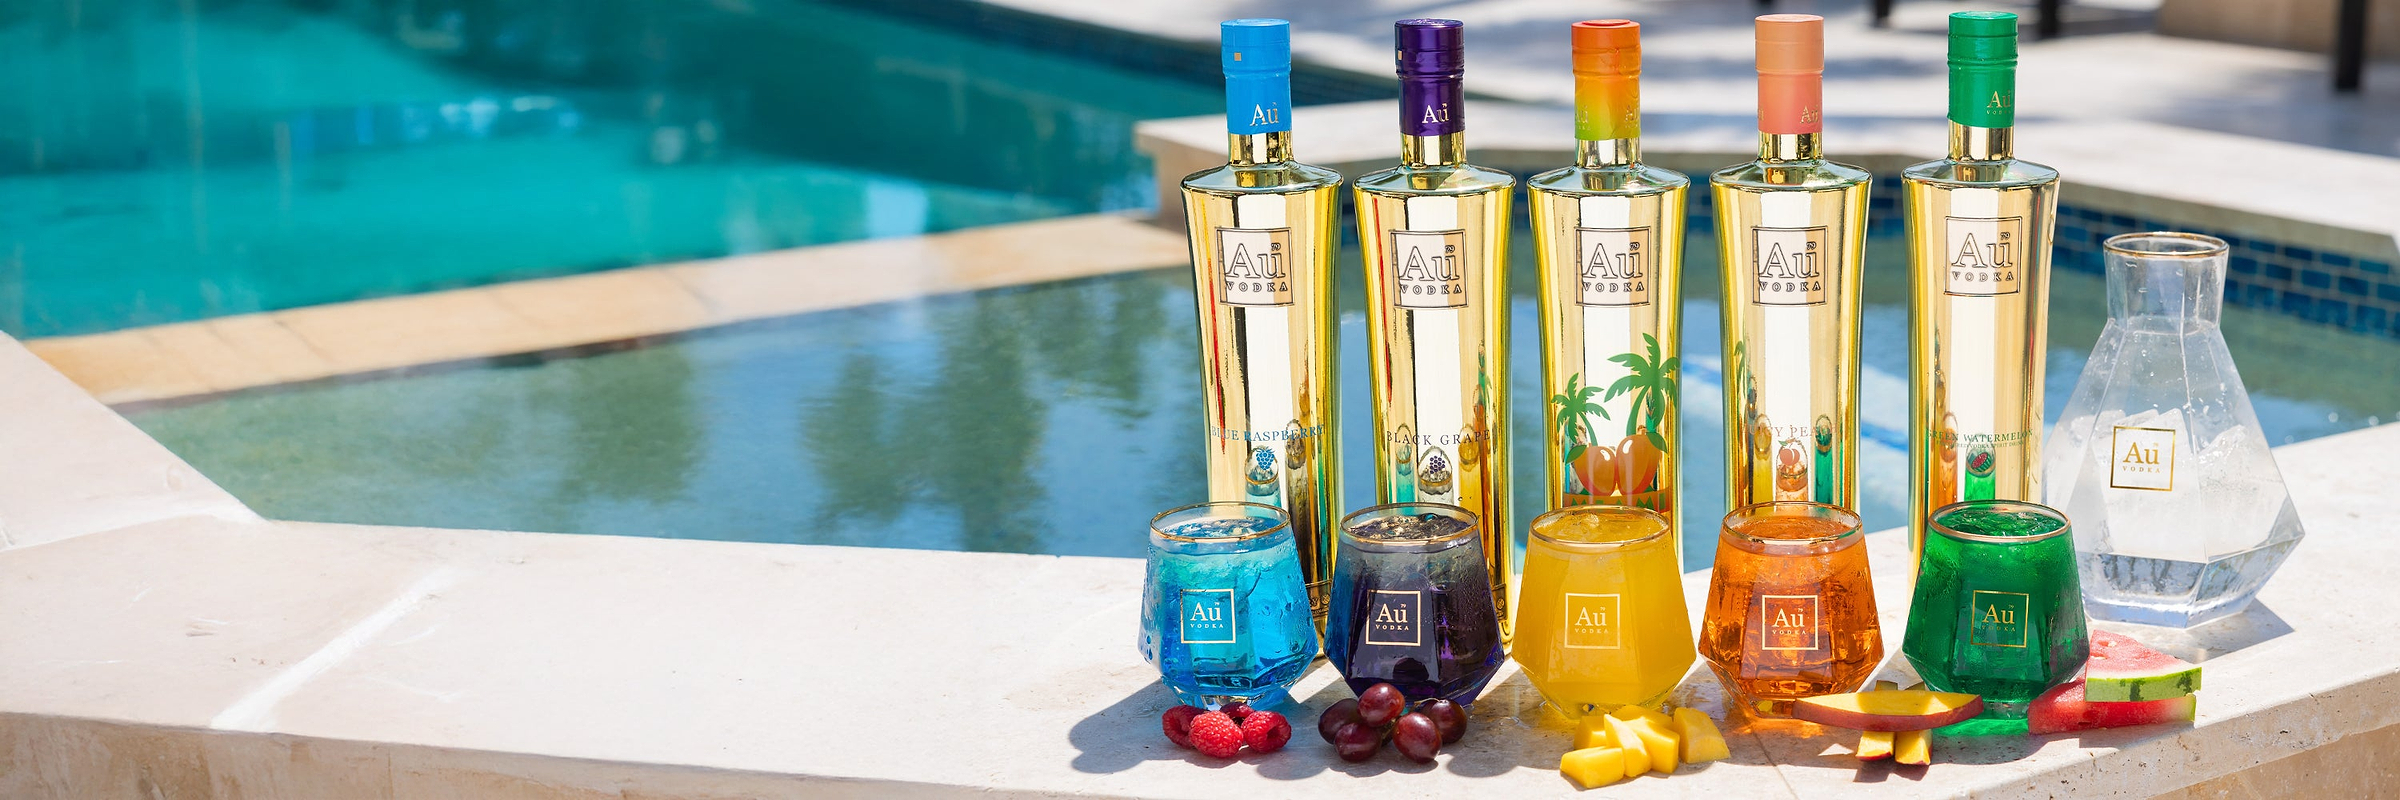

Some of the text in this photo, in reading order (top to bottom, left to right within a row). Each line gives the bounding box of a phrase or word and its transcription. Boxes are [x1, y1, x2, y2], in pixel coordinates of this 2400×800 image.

[1986, 91, 2012, 109] Au
[1249, 102, 1280, 127] Au
[1421, 103, 1450, 124] Au
[1952, 232, 2013, 269] Au
[1225, 243, 1286, 280] Au
[1399, 245, 1460, 282] Au
[1582, 242, 1643, 280] Au
[1759, 242, 1820, 279] Au
[1952, 270, 2015, 282] VODKA
[1225, 281, 1289, 293] VODKA
[1399, 284, 1463, 296] VODKA
[1582, 281, 1645, 293] VODKA
[1759, 280, 1822, 293] VODKA
[1211, 424, 1324, 442] BLUE RASPBERRY
[1386, 430, 1491, 446] BLACK GRAPE
[1745, 424, 1783, 438] UICY
[1964, 429, 2033, 443] WATERMELON
[2122, 441, 2160, 465] Au
[2122, 465, 2161, 474] VODKA
[1190, 602, 1222, 621] Au
[1375, 603, 1408, 623] Au
[1575, 606, 1607, 626] Au
[1772, 608, 1805, 627] Au
[1982, 604, 2015, 624] Au
